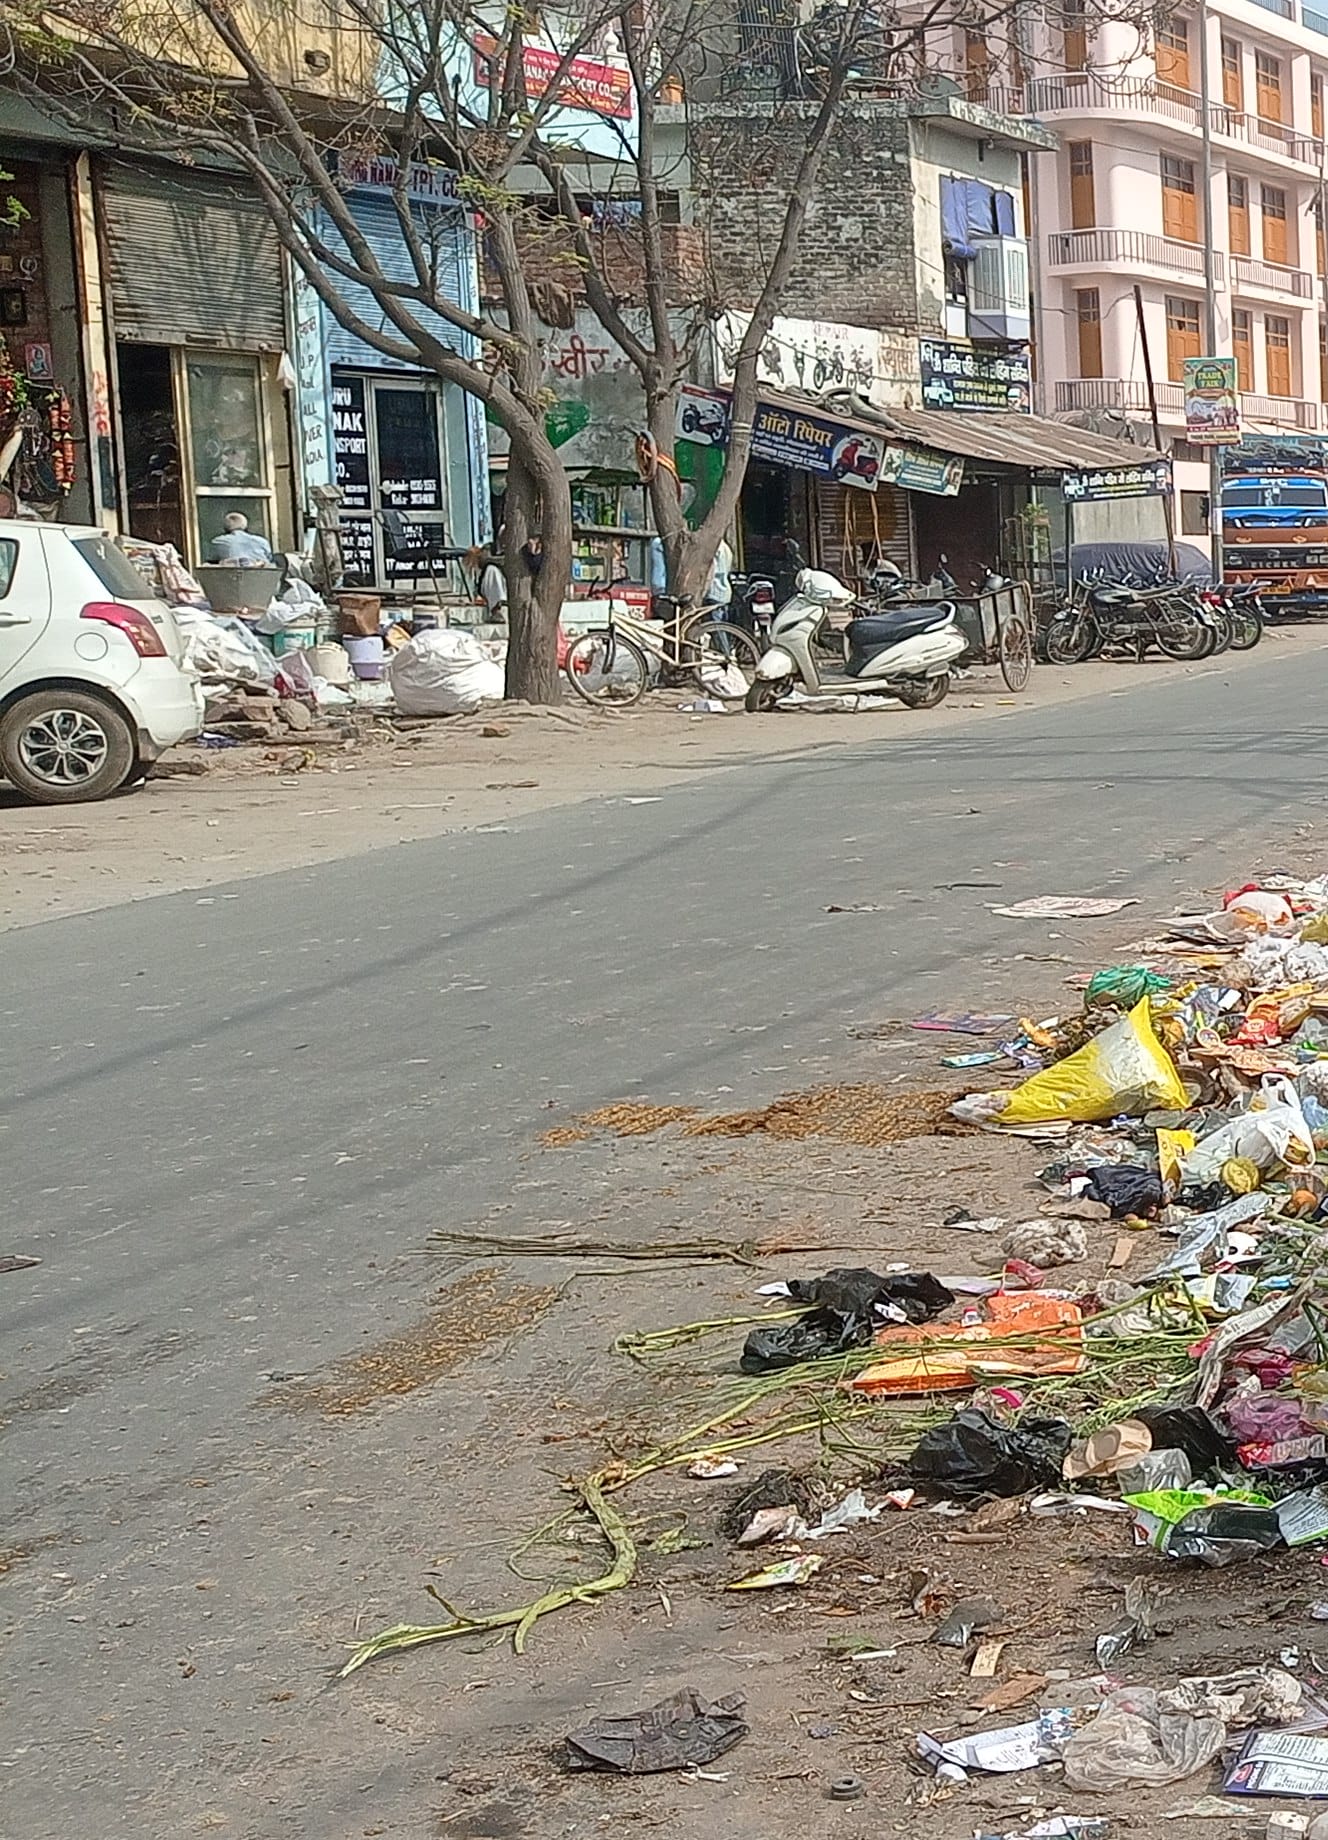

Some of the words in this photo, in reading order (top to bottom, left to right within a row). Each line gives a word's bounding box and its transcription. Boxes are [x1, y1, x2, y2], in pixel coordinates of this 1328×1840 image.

[331, 386, 352, 407] URU
[332, 411, 364, 432] NAK
[758, 411, 791, 436] ऑटो
[793, 419, 834, 448] रिपेयर
